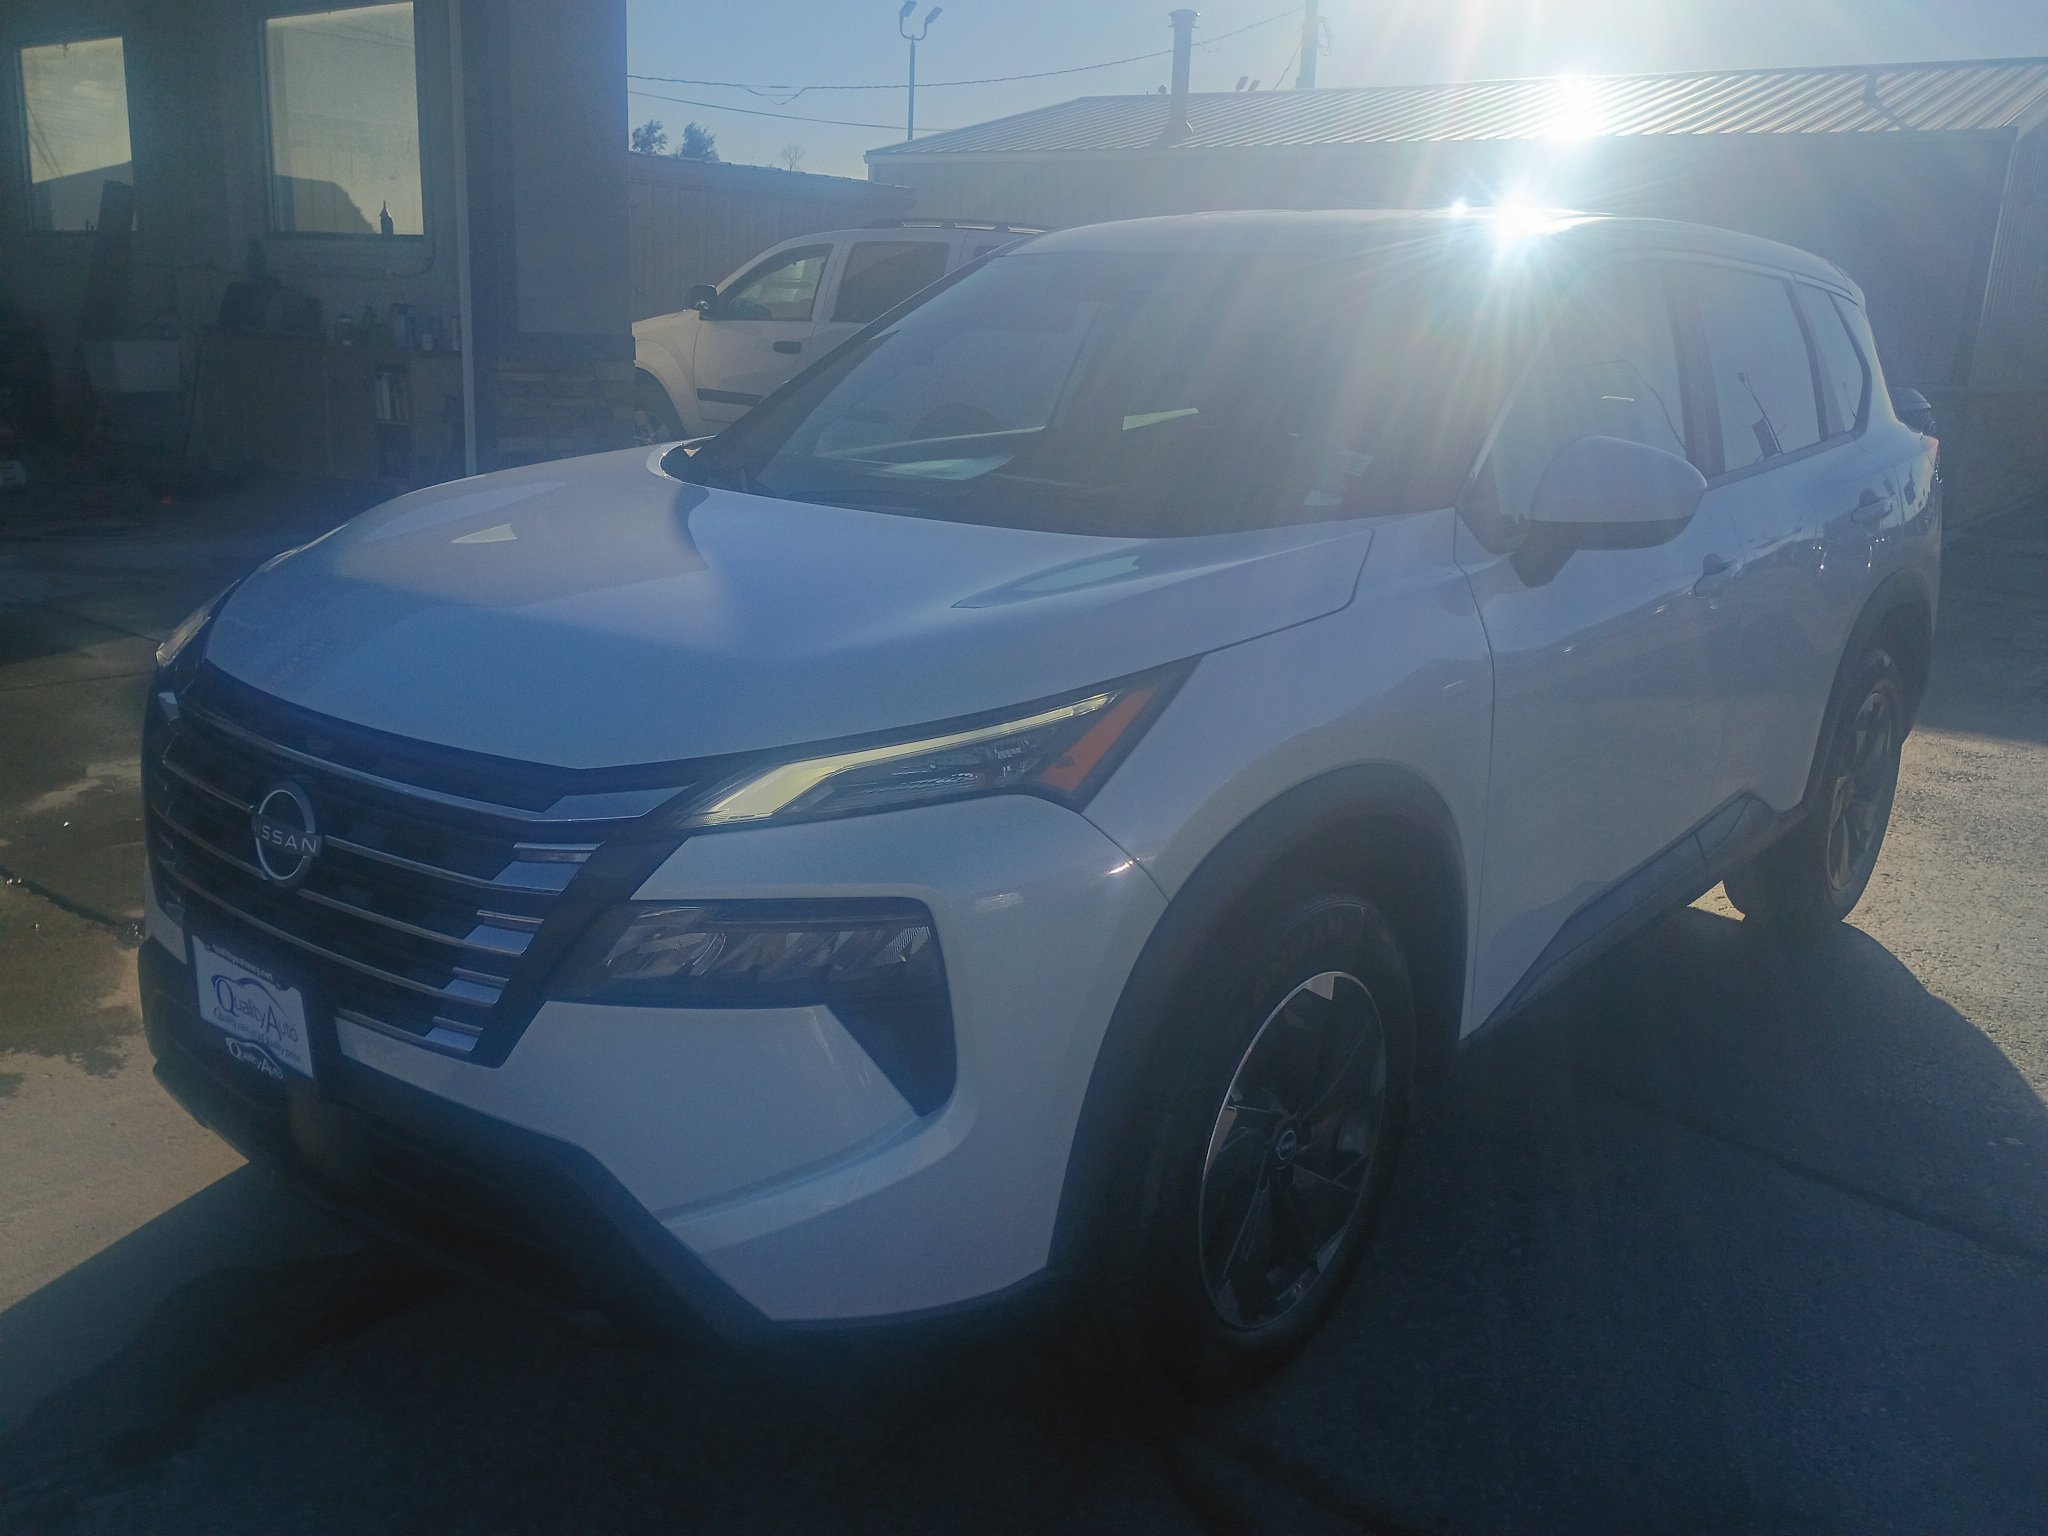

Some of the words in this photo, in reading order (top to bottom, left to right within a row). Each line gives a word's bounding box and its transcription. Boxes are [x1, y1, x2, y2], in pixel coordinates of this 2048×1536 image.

[252, 816, 317, 854] SSAN
[216, 978, 266, 1029] Quality
[266, 1005, 299, 1043] Auto
